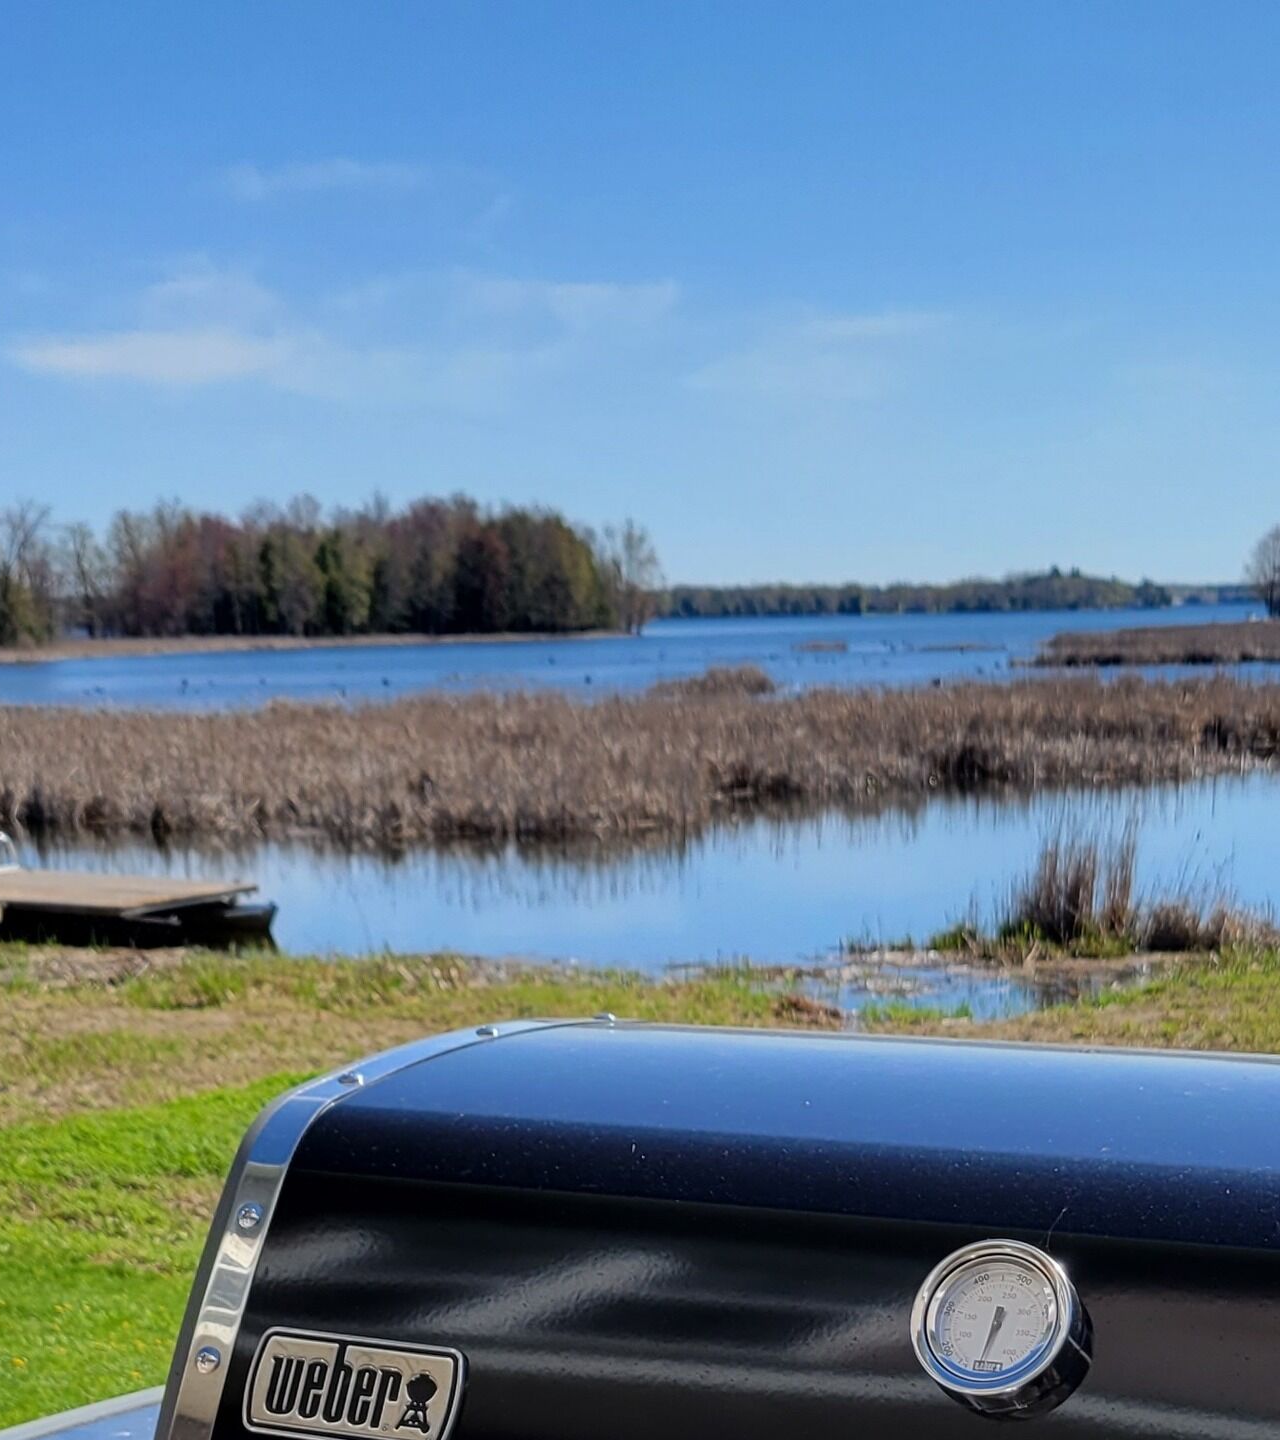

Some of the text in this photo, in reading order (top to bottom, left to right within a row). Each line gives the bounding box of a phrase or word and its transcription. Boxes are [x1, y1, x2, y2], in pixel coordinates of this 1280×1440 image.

[974, 1274, 990, 1284] 400
[1016, 1274, 1032, 1286] 500
[944, 1301, 954, 1316] 300
[942, 1341, 953, 1357] 200
[264, 1343, 403, 1429] weber
